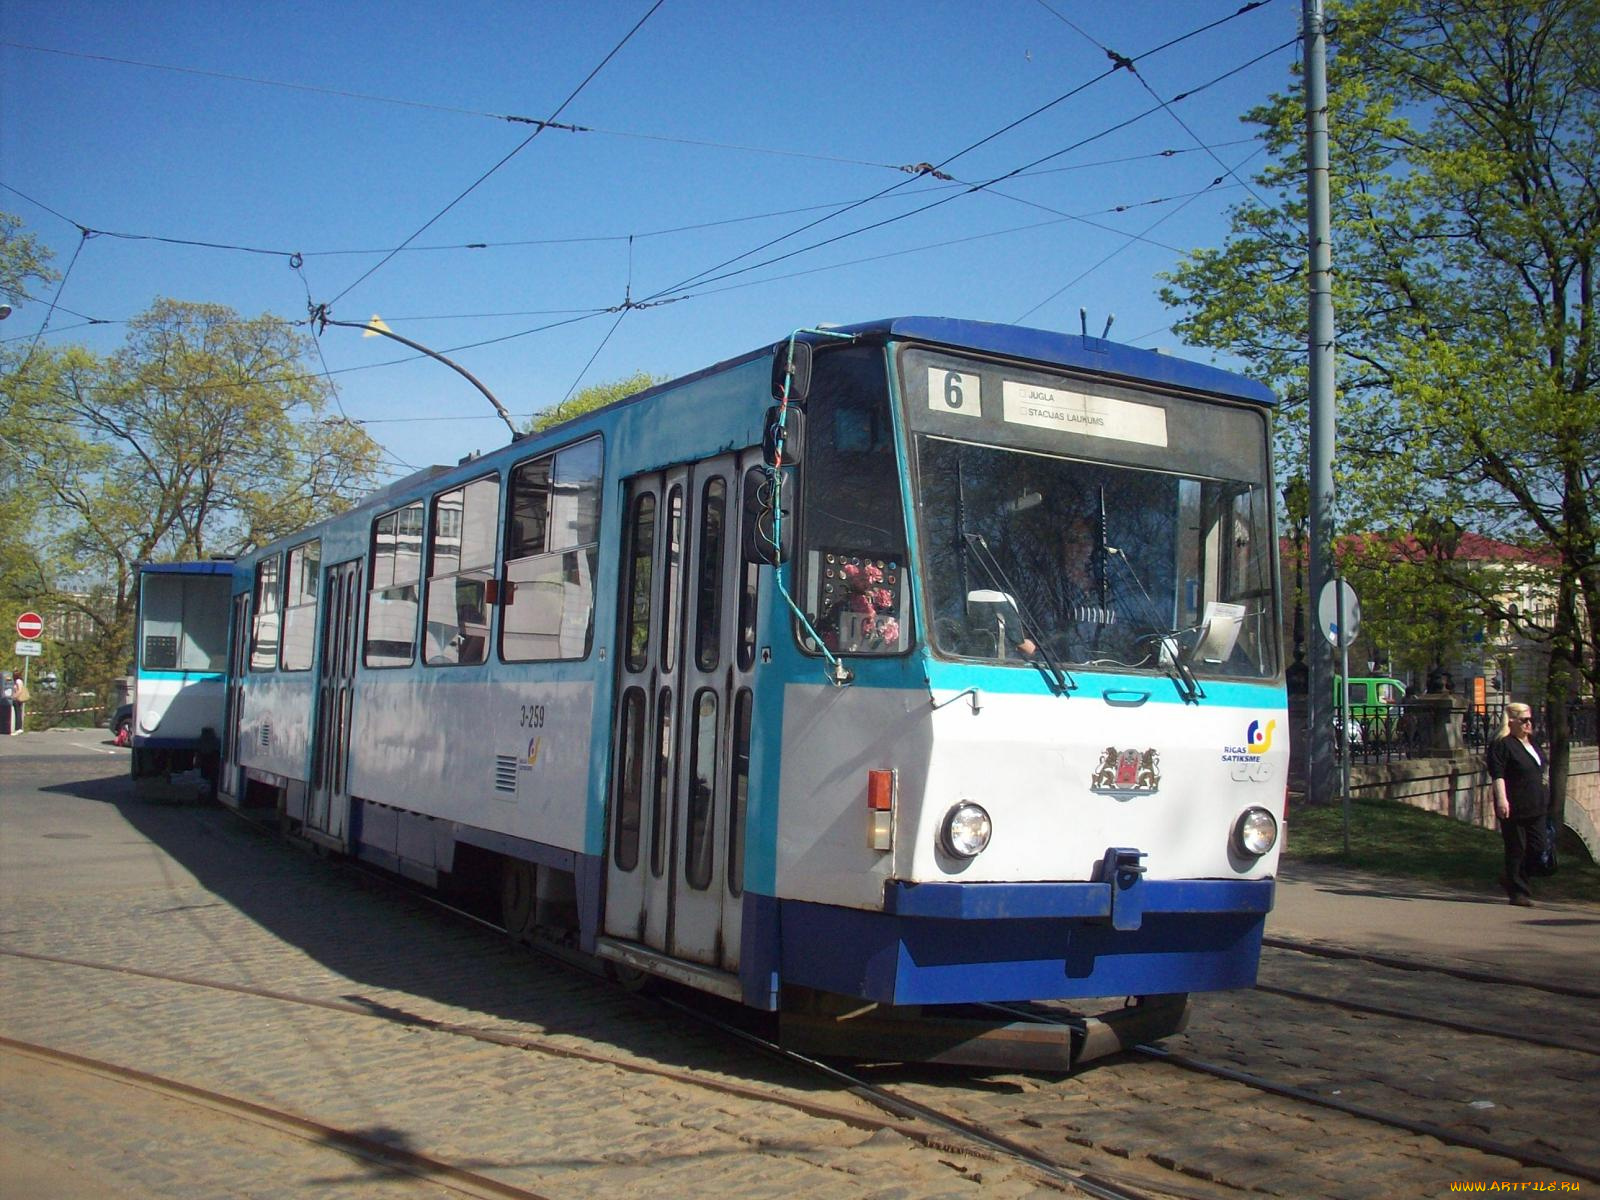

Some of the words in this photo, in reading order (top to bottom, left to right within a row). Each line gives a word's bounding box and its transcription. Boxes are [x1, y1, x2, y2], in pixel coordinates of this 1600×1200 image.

[943, 369, 963, 409] 6
[1029, 391, 1054, 401] JUGLA
[520, 705, 544, 728] 3-259
